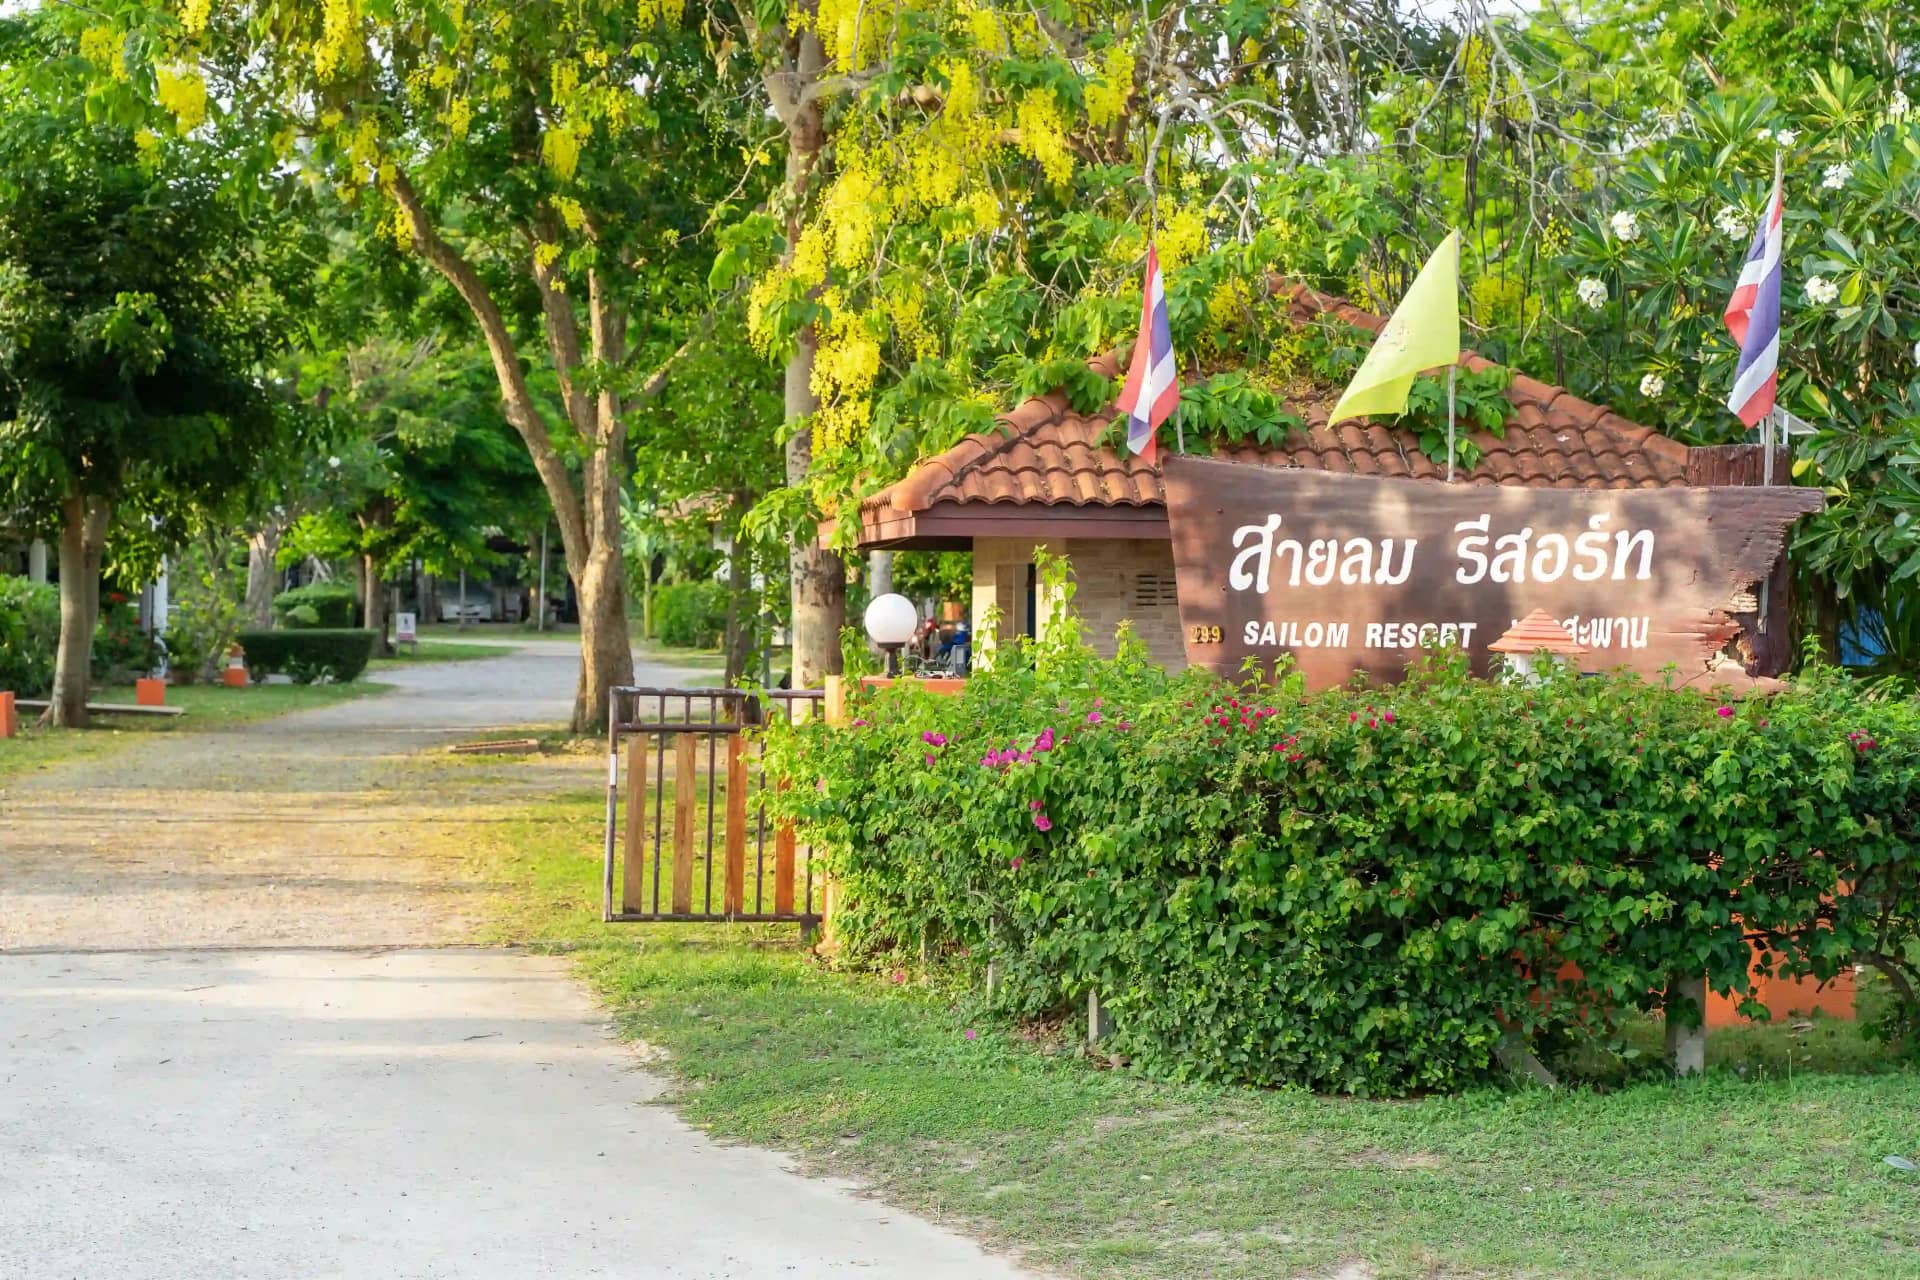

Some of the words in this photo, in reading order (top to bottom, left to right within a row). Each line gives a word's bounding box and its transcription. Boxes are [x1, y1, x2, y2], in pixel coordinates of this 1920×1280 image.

[1229, 513, 1418, 594] สายลม
[1453, 511, 1655, 585] รีสอร์ท
[1243, 620, 1349, 649] SAILOM
